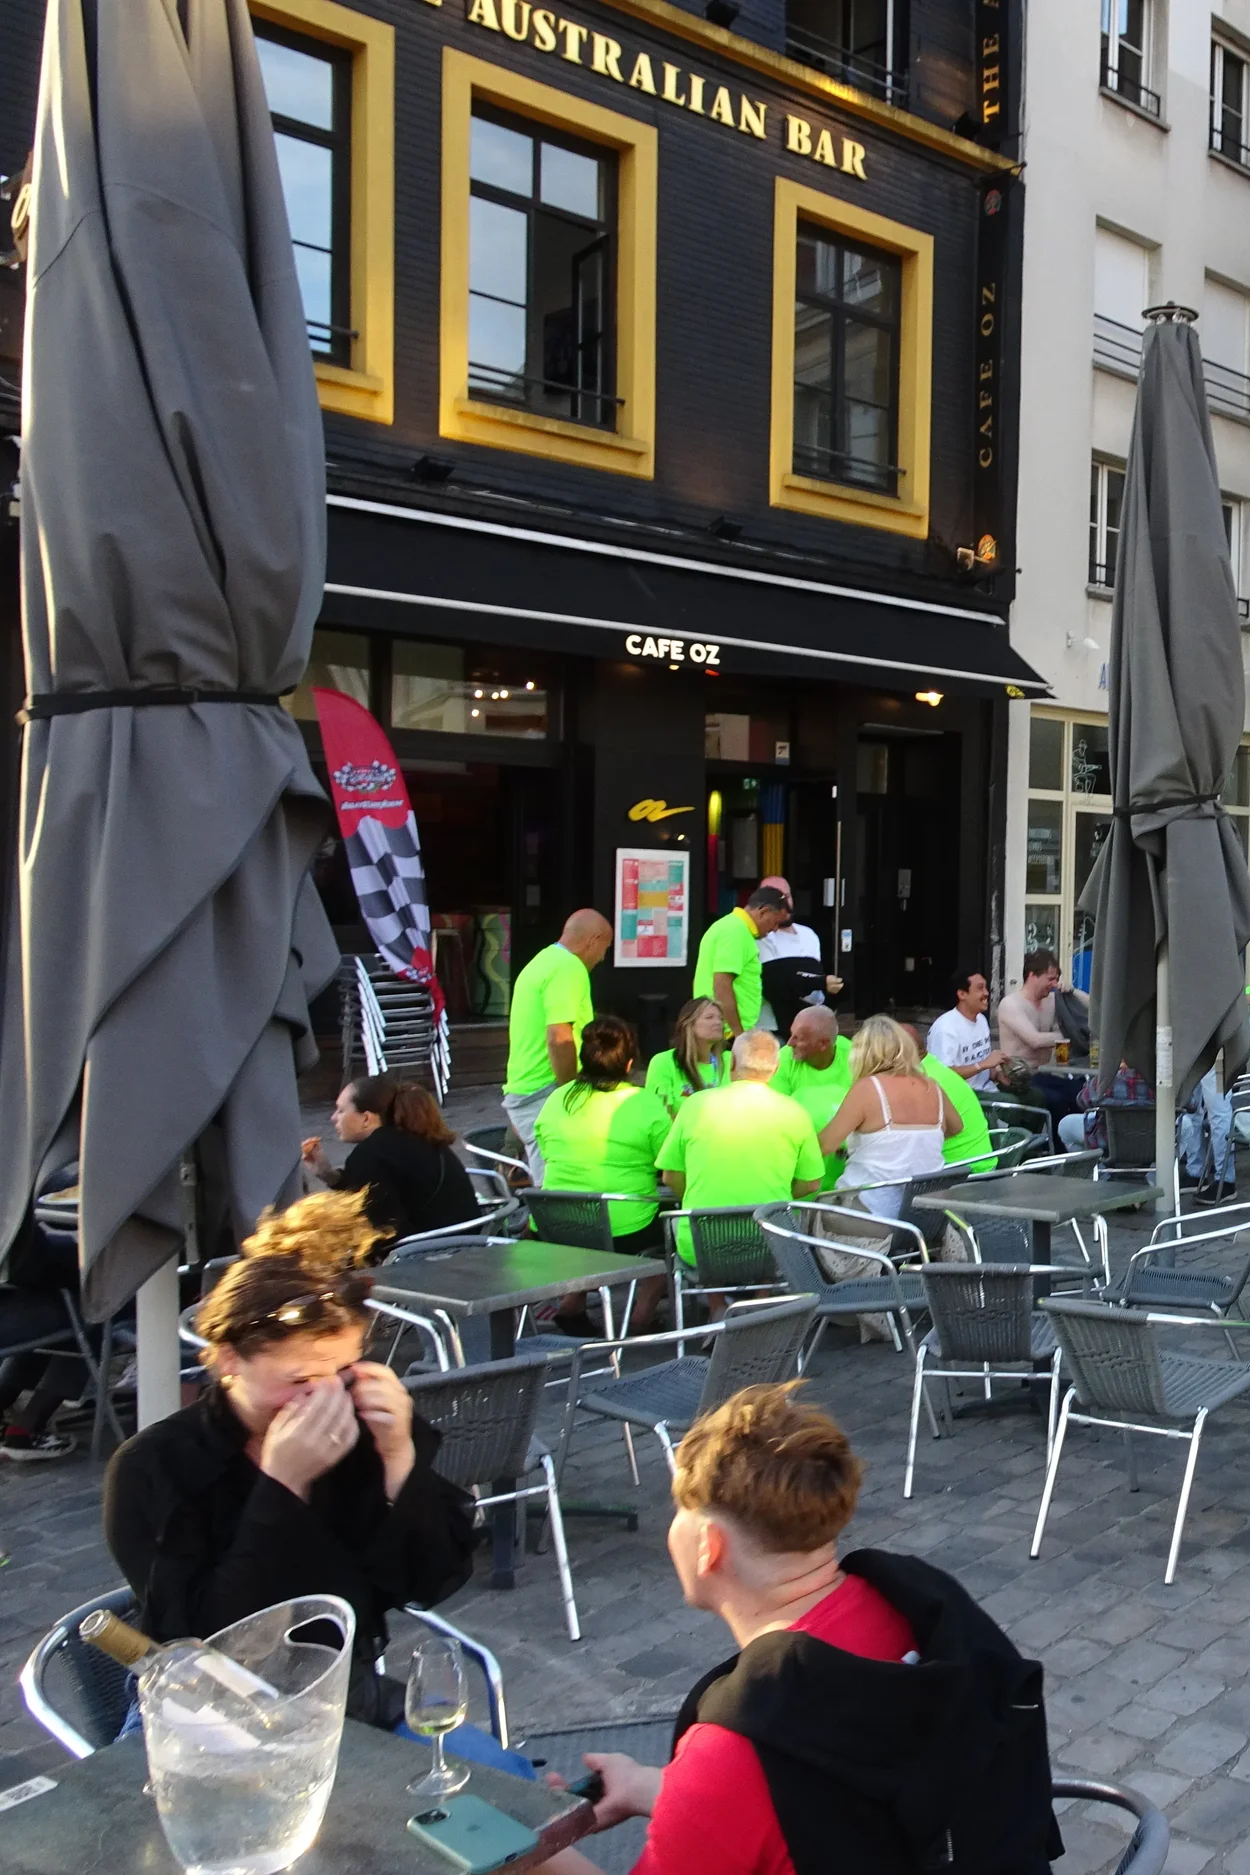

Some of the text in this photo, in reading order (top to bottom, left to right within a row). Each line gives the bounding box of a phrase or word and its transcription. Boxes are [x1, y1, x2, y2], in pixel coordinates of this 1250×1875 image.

[467, 0, 868, 180] AUSTRALIAN BAR
[982, 33, 1000, 124] THE
[978, 282, 996, 469] CAFE OZ
[625, 634, 721, 665] CAFE OZ
